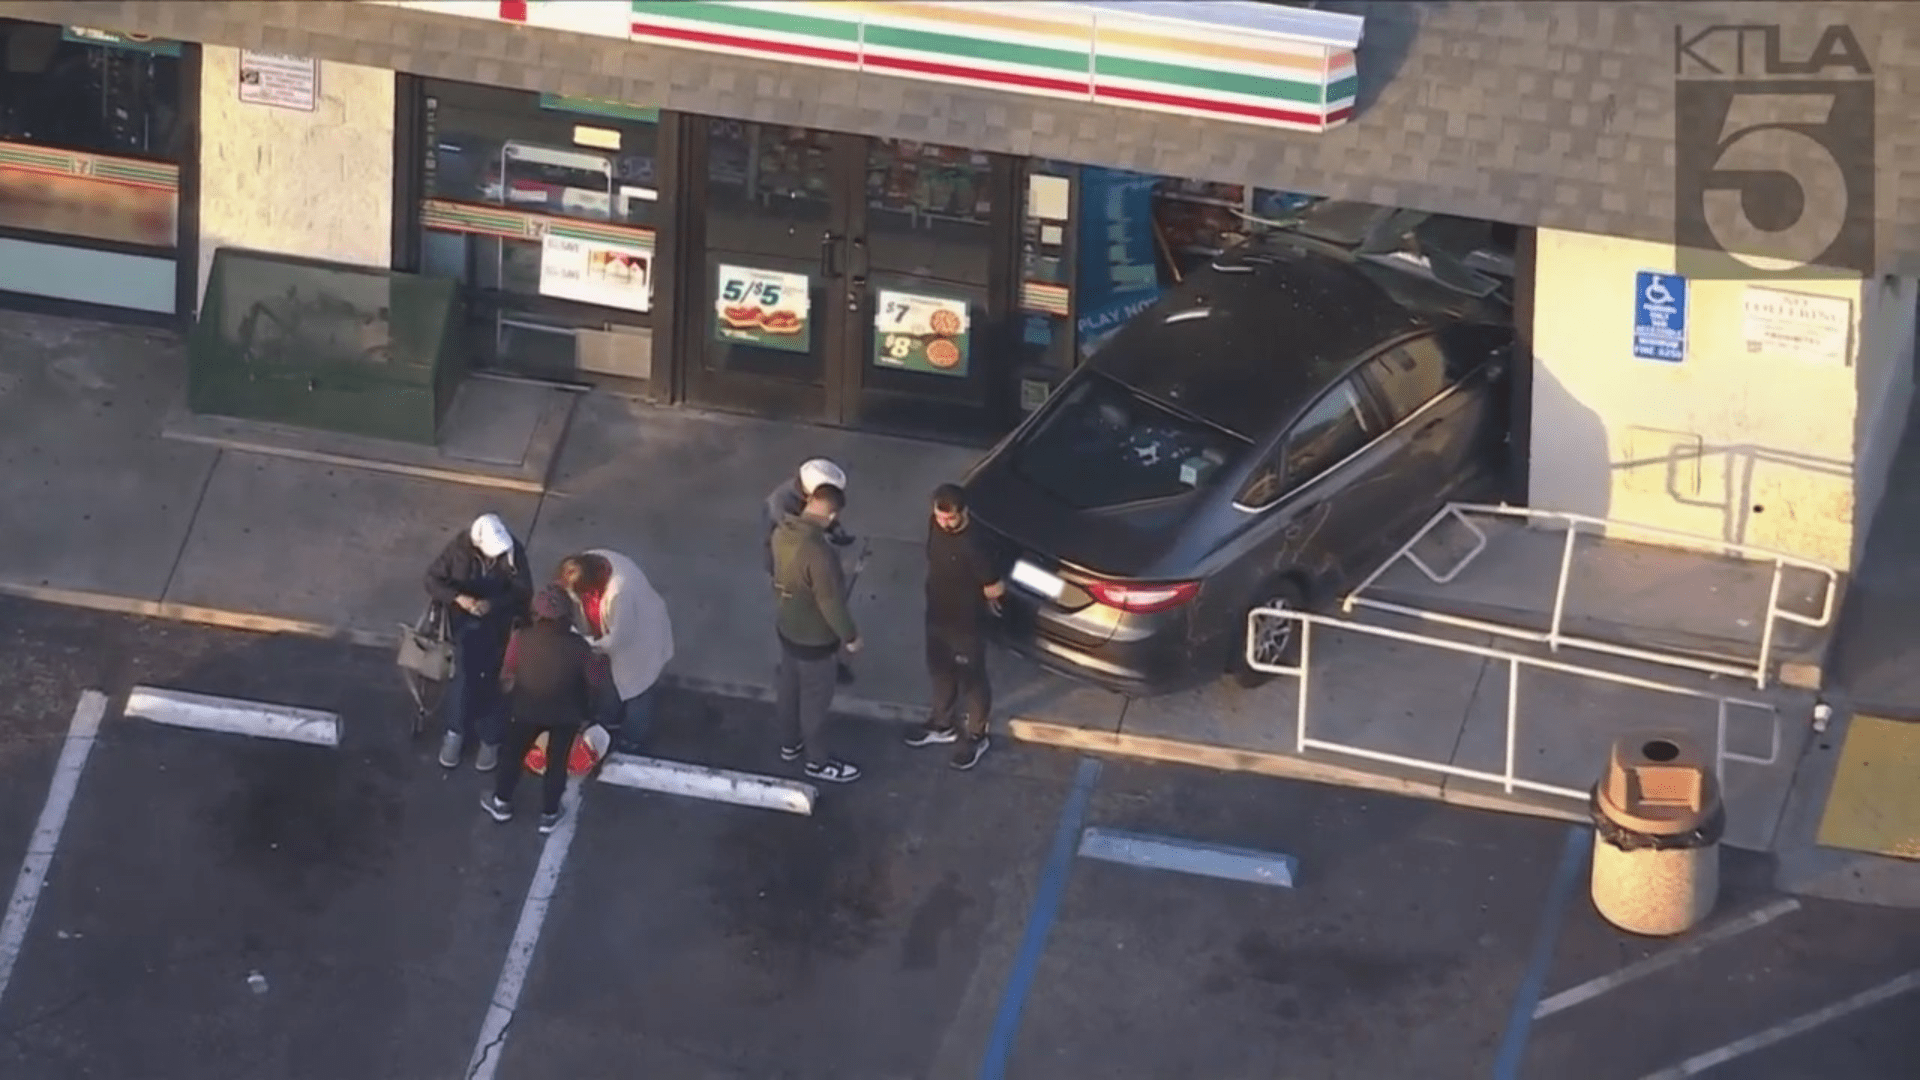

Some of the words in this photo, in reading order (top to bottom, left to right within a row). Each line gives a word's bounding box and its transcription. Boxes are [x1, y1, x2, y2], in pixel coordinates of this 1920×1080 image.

[723, 279, 782, 306] 5/$5
[886, 301, 910, 324] $7
[1078, 308, 1120, 332] PLAY
[885, 334, 912, 358] $8
